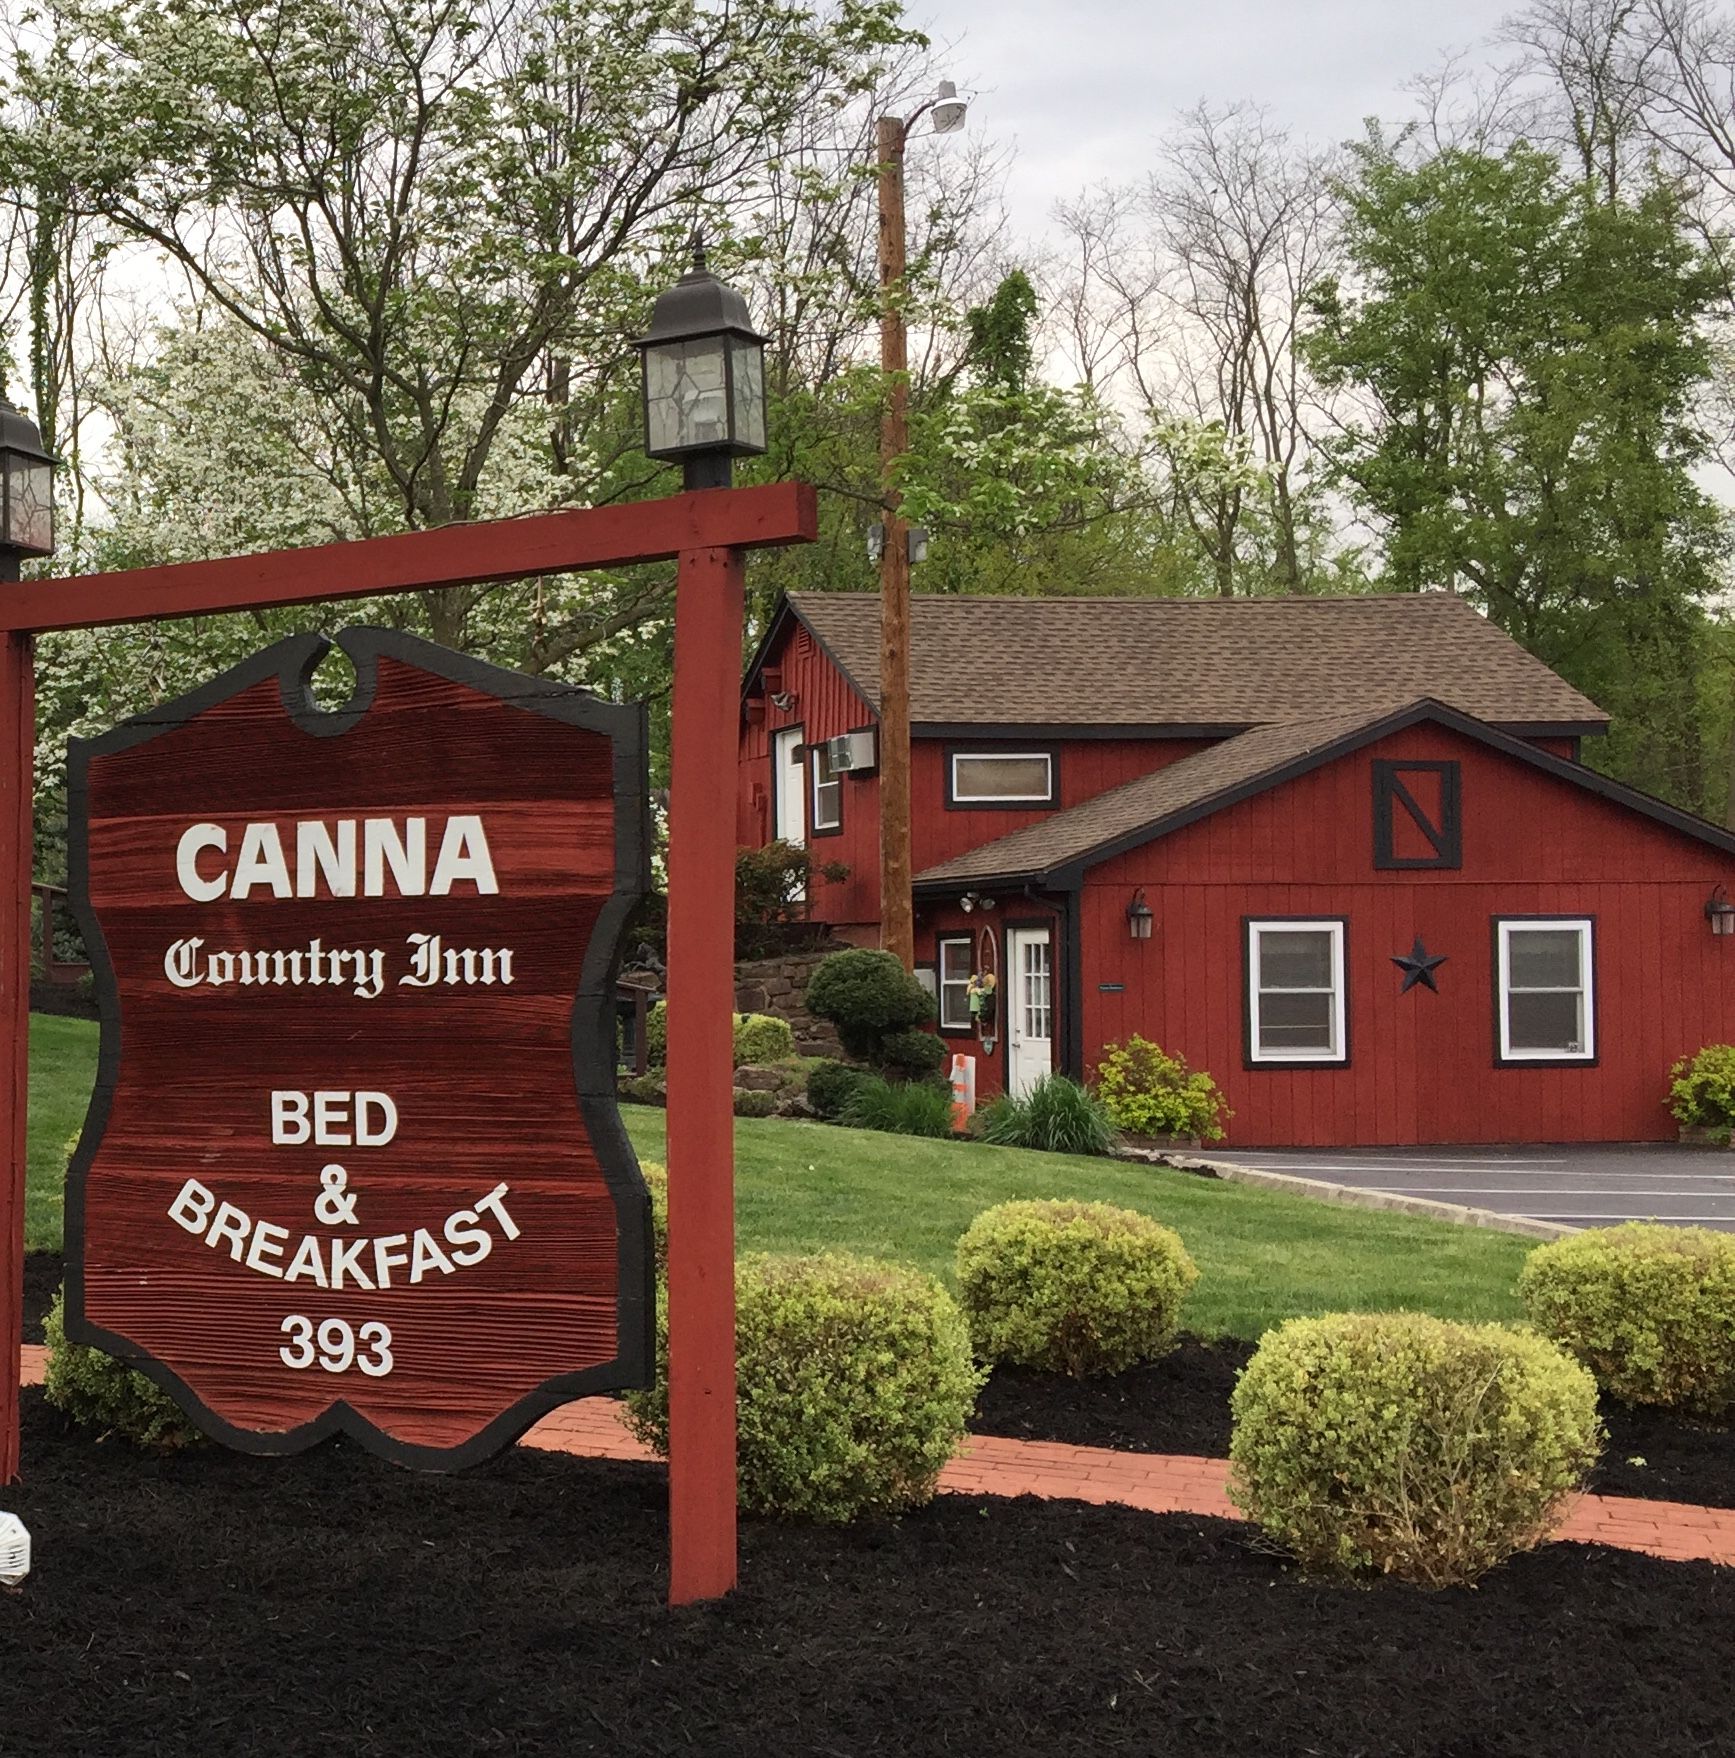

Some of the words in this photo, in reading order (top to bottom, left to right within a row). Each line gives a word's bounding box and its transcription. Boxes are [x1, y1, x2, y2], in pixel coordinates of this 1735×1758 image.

[176, 815, 499, 902] CANNA
[164, 936, 386, 999] Country
[398, 932, 516, 987] Inn
[271, 1090, 398, 1146] BED
[314, 1163, 360, 1225] &
[167, 1178, 522, 1290] BREAKFAST
[278, 1314, 395, 1377] 393
